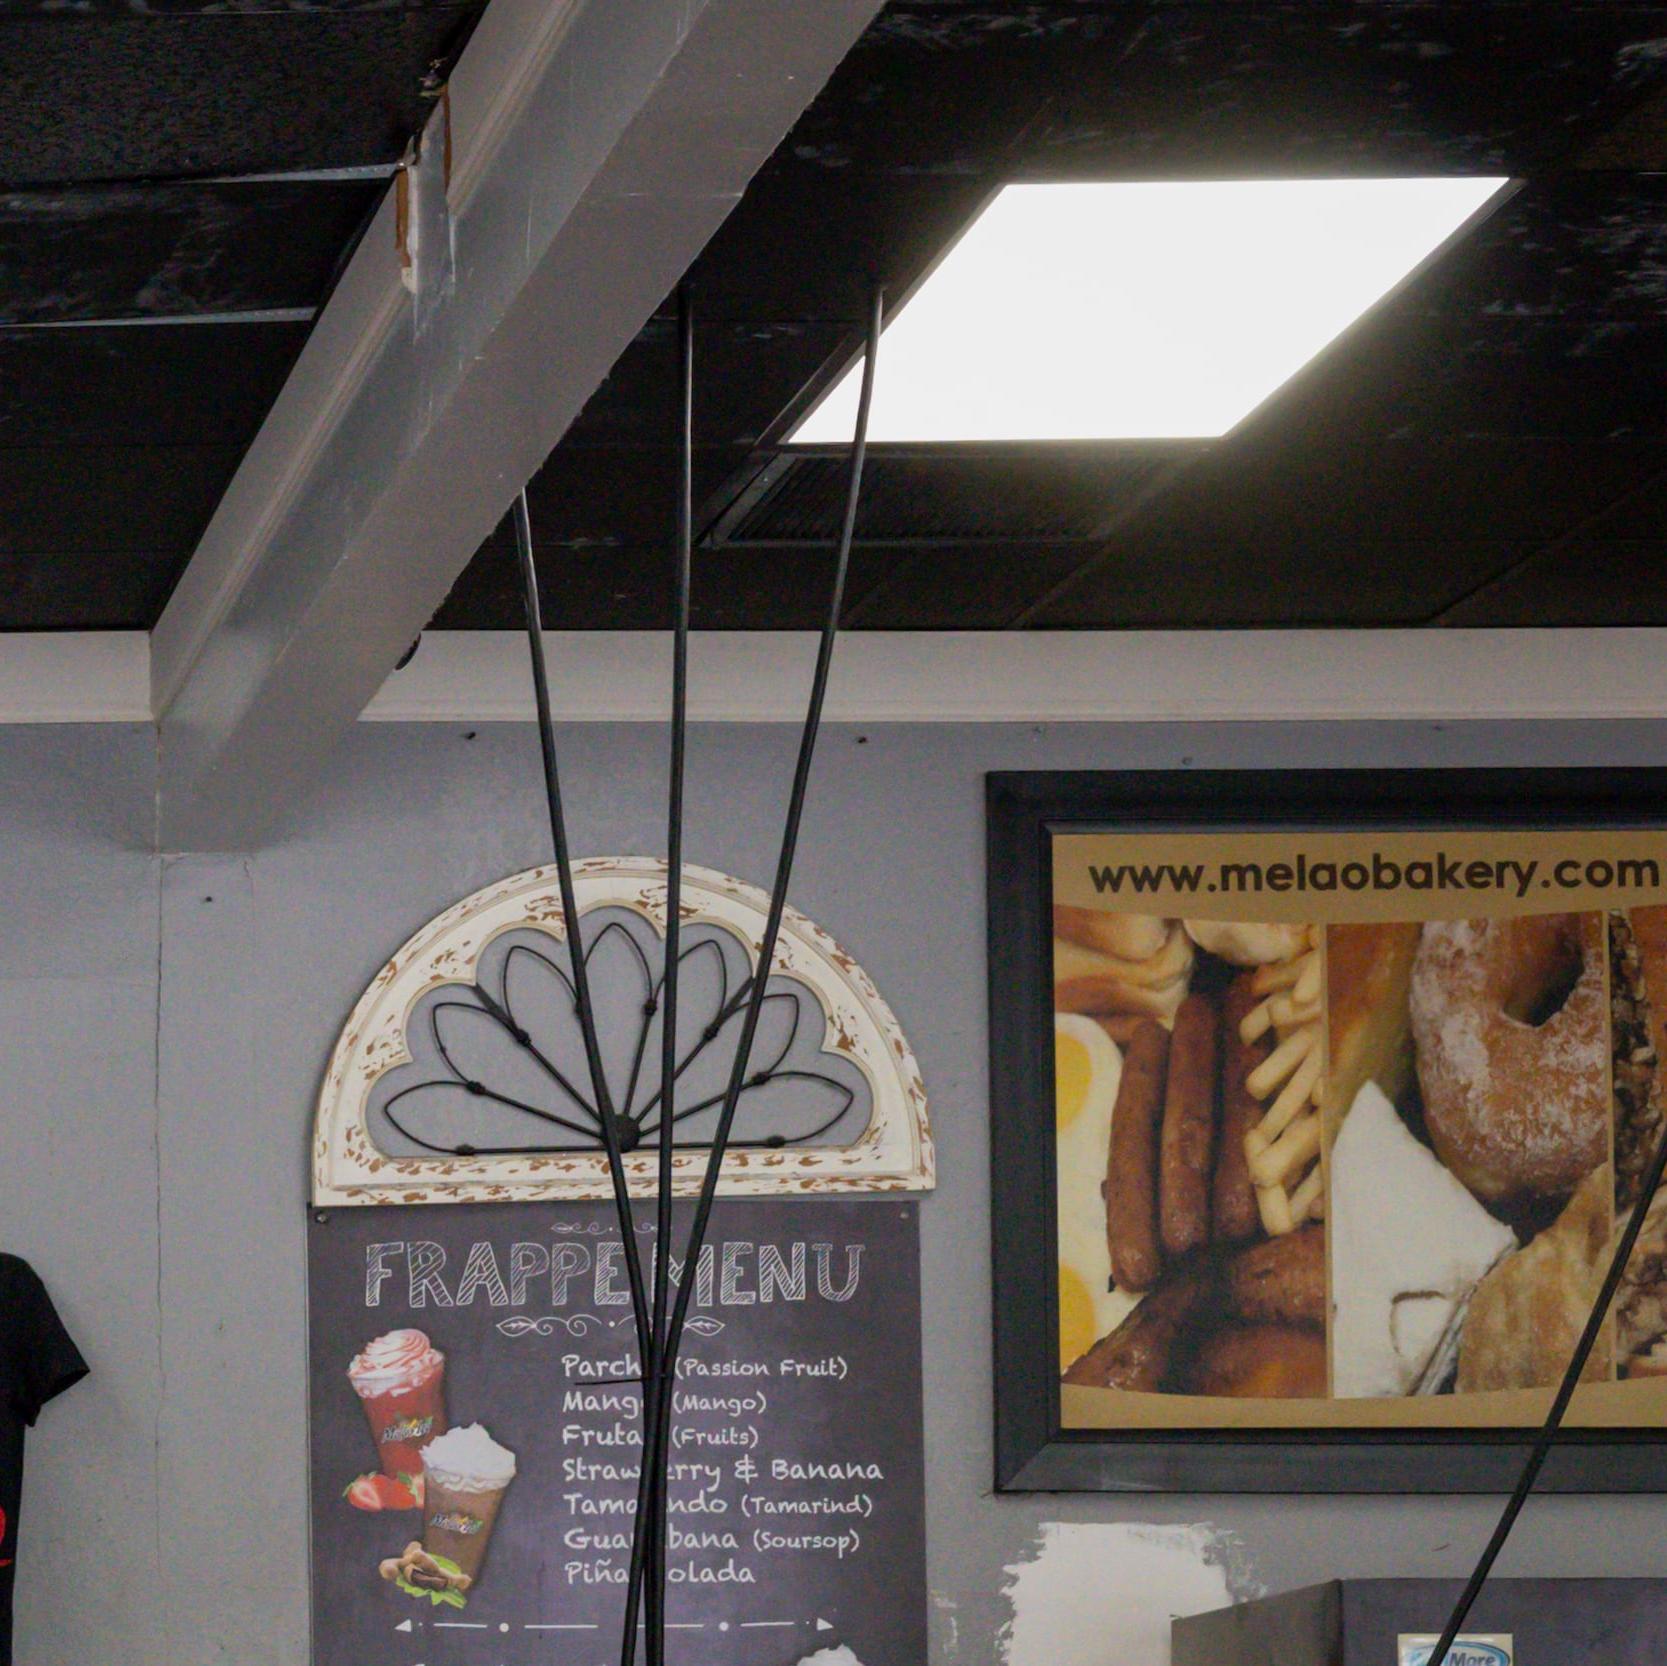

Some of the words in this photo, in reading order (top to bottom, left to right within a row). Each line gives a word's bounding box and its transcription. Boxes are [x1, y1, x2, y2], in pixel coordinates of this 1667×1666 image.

[1088, 852, 1660, 897] www.melaobakery.com
[365, 1241, 631, 1307] FRAPPE
[561, 1353, 647, 1379] Parch
[674, 1357, 771, 1380] (Passion
[780, 1358, 848, 1379] Fruit)
[561, 1392, 647, 1420] Mang
[673, 1392, 768, 1415] (Mango)
[561, 1424, 647, 1447] Fruta
[671, 1427, 759, 1449] (Fruits)
[561, 1458, 721, 1491] Strawerry
[734, 1458, 758, 1484] &
[771, 1459, 885, 1482] Banana
[563, 1492, 728, 1516] Tamando
[741, 1494, 873, 1518] (Tamarind)
[752, 1529, 861, 1558] (Soursop)
[564, 1560, 630, 1585] Piña
[667, 1561, 757, 1584] olada
